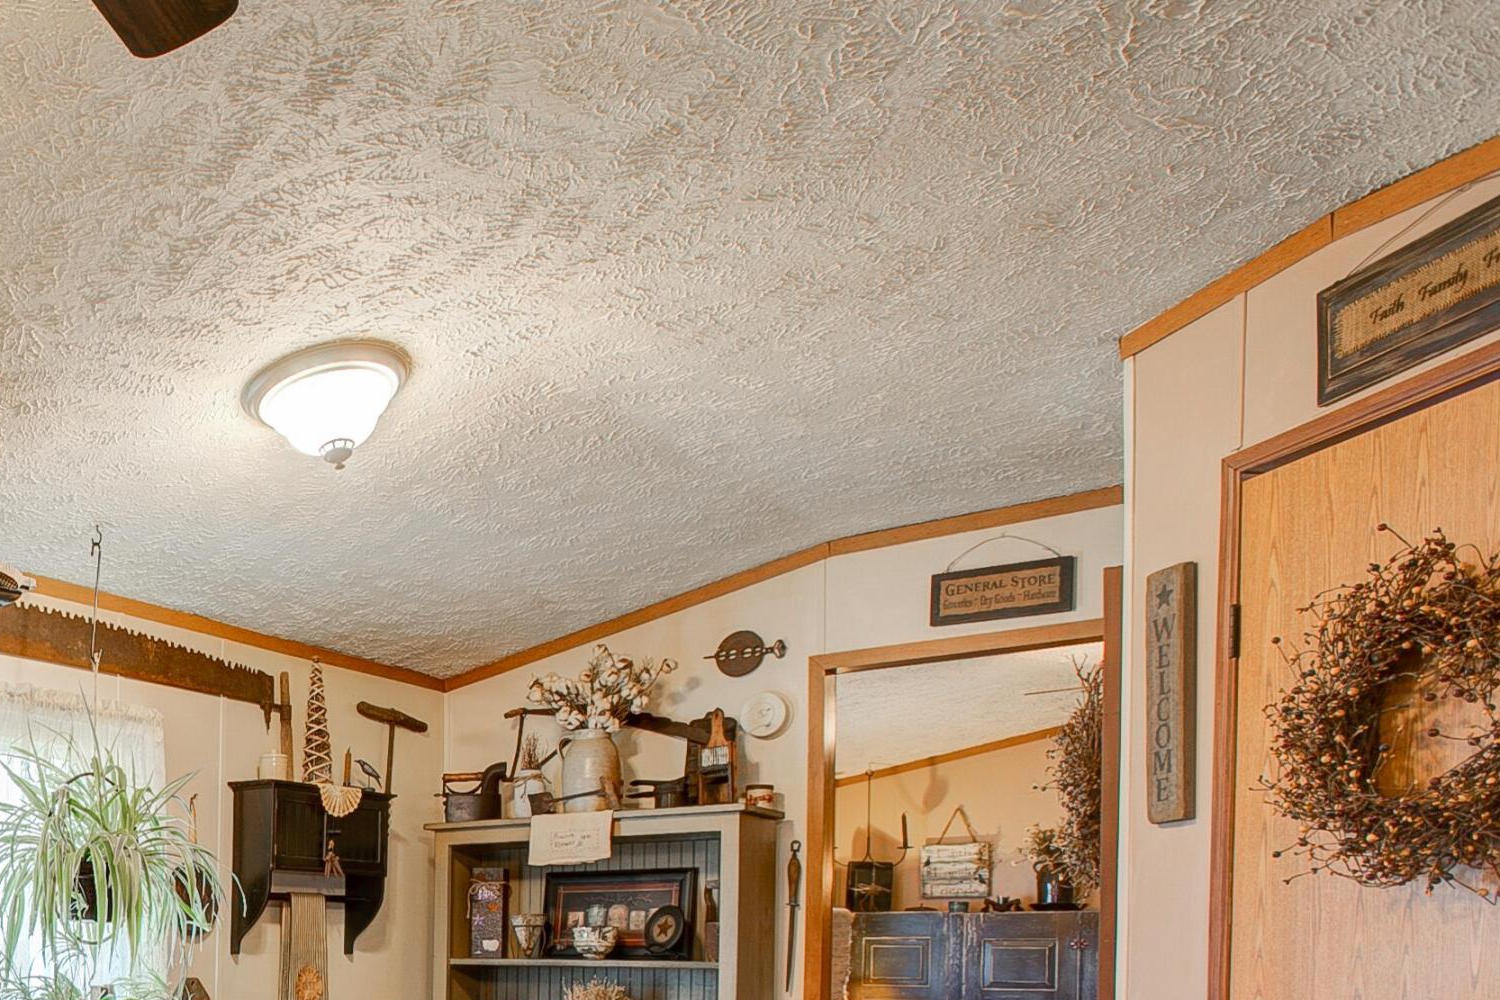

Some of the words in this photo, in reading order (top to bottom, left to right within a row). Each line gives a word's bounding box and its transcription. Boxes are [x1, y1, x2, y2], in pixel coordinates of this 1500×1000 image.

[1369, 293, 1405, 324] Faith
[1417, 262, 1469, 301] Family
[945, 579, 1007, 597] GENERAL
[1011, 573, 1057, 589] STORE
[1151, 612, 1177, 803] WELCOME
